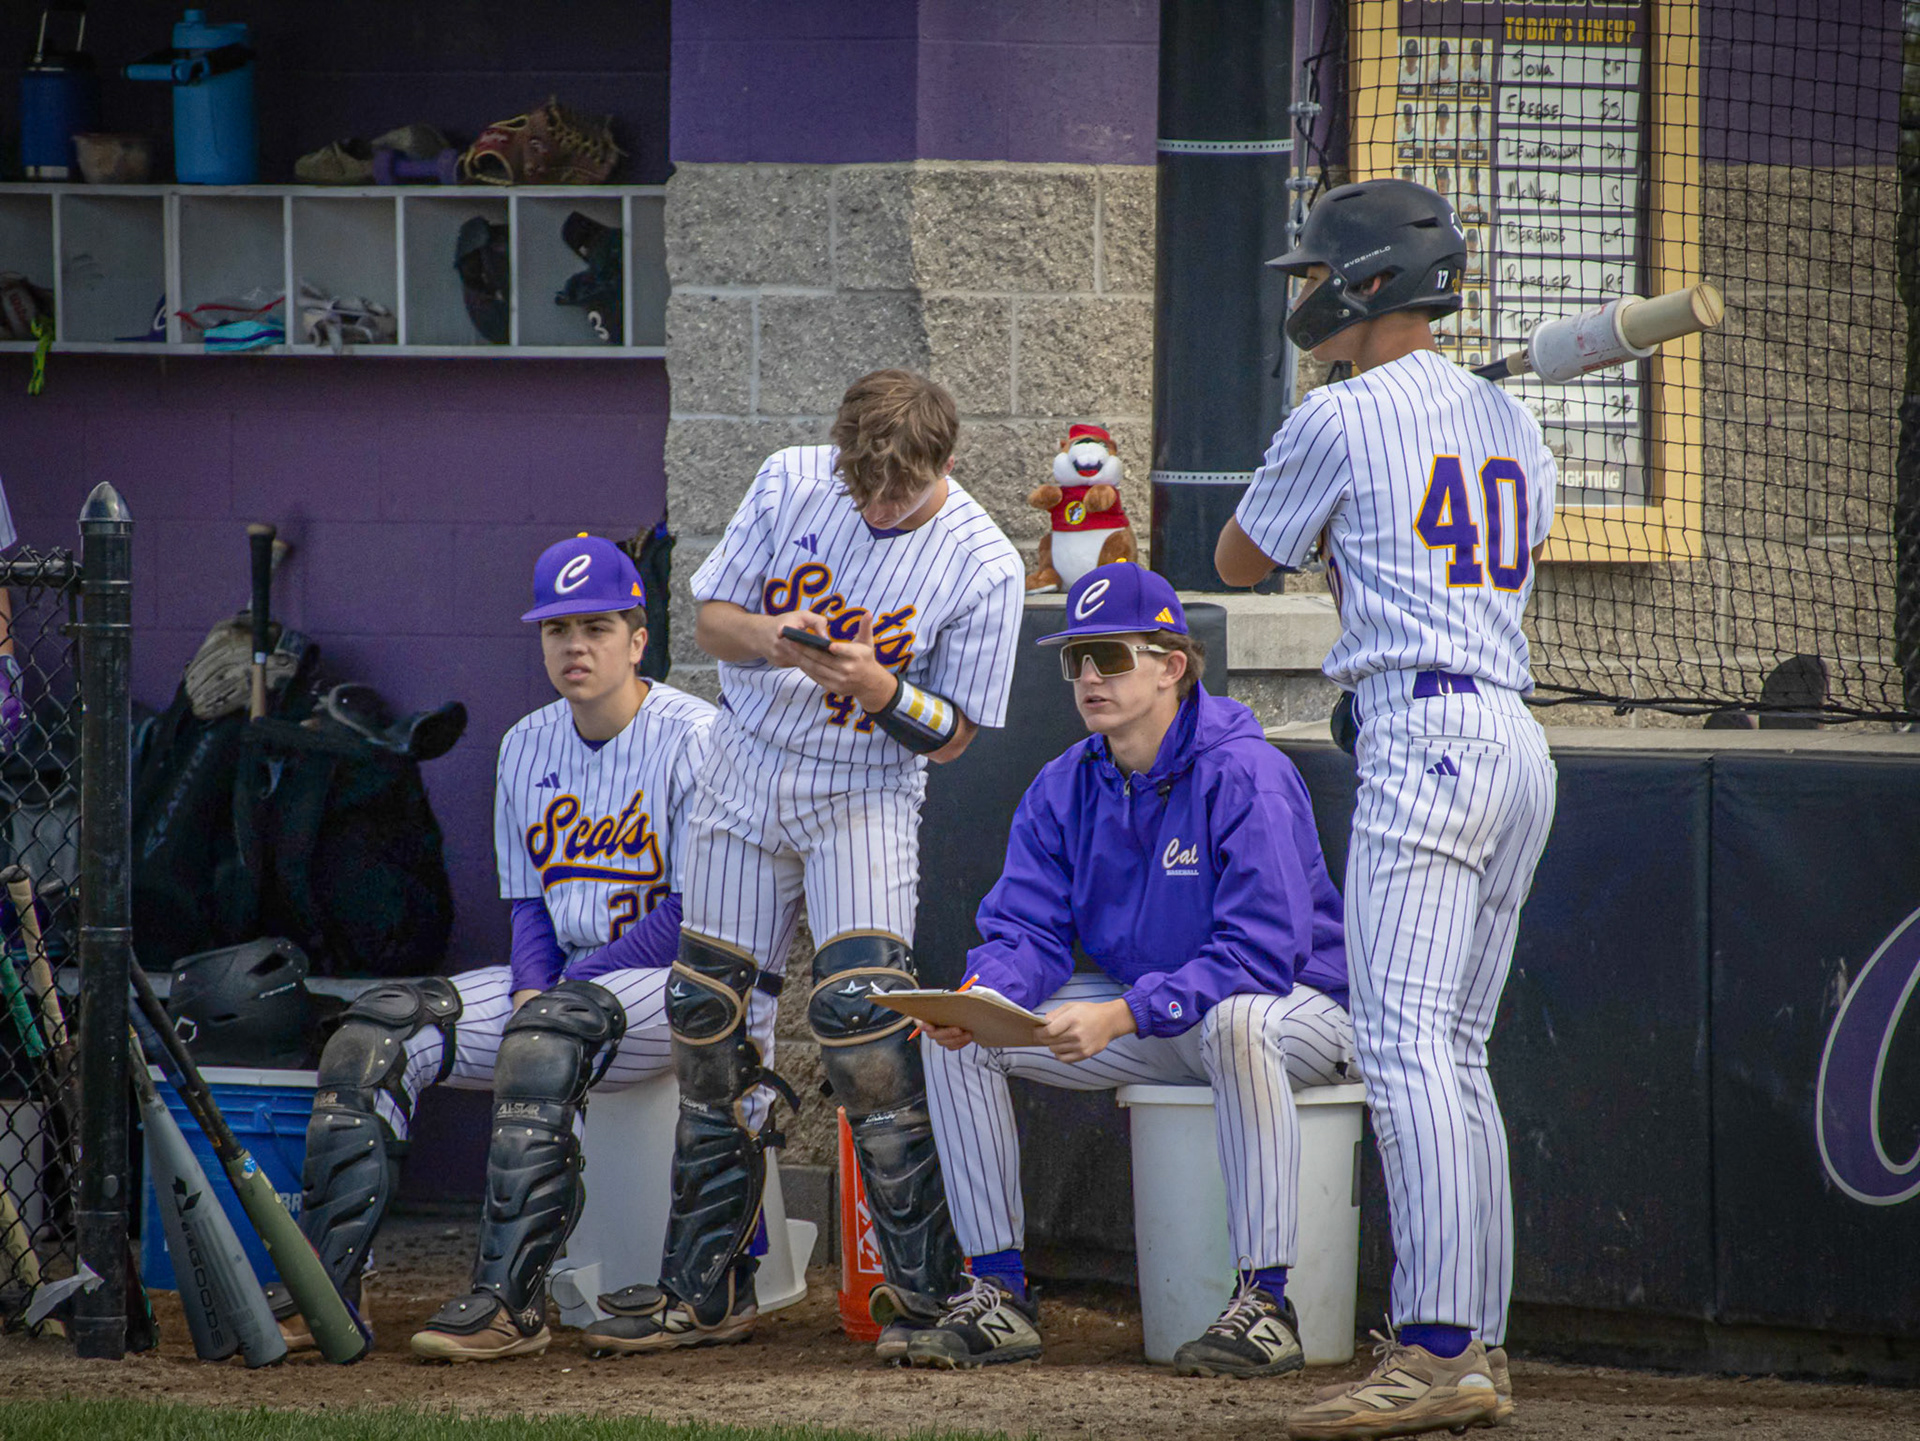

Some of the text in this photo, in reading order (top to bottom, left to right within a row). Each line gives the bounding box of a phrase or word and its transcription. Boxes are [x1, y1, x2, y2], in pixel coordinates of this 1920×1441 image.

[1504, 17, 1637, 43] TODAY'S LINEUP
[1611, 184, 1620, 203] C
[1343, 245, 1391, 269] EVOSHIELD
[1436, 269, 1450, 289] 17
[1412, 453, 1531, 594] 40
[554, 554, 592, 595] C
[1074, 578, 1111, 621] C
[526, 788, 656, 872] Scots
[1163, 837, 1200, 869] Cal
